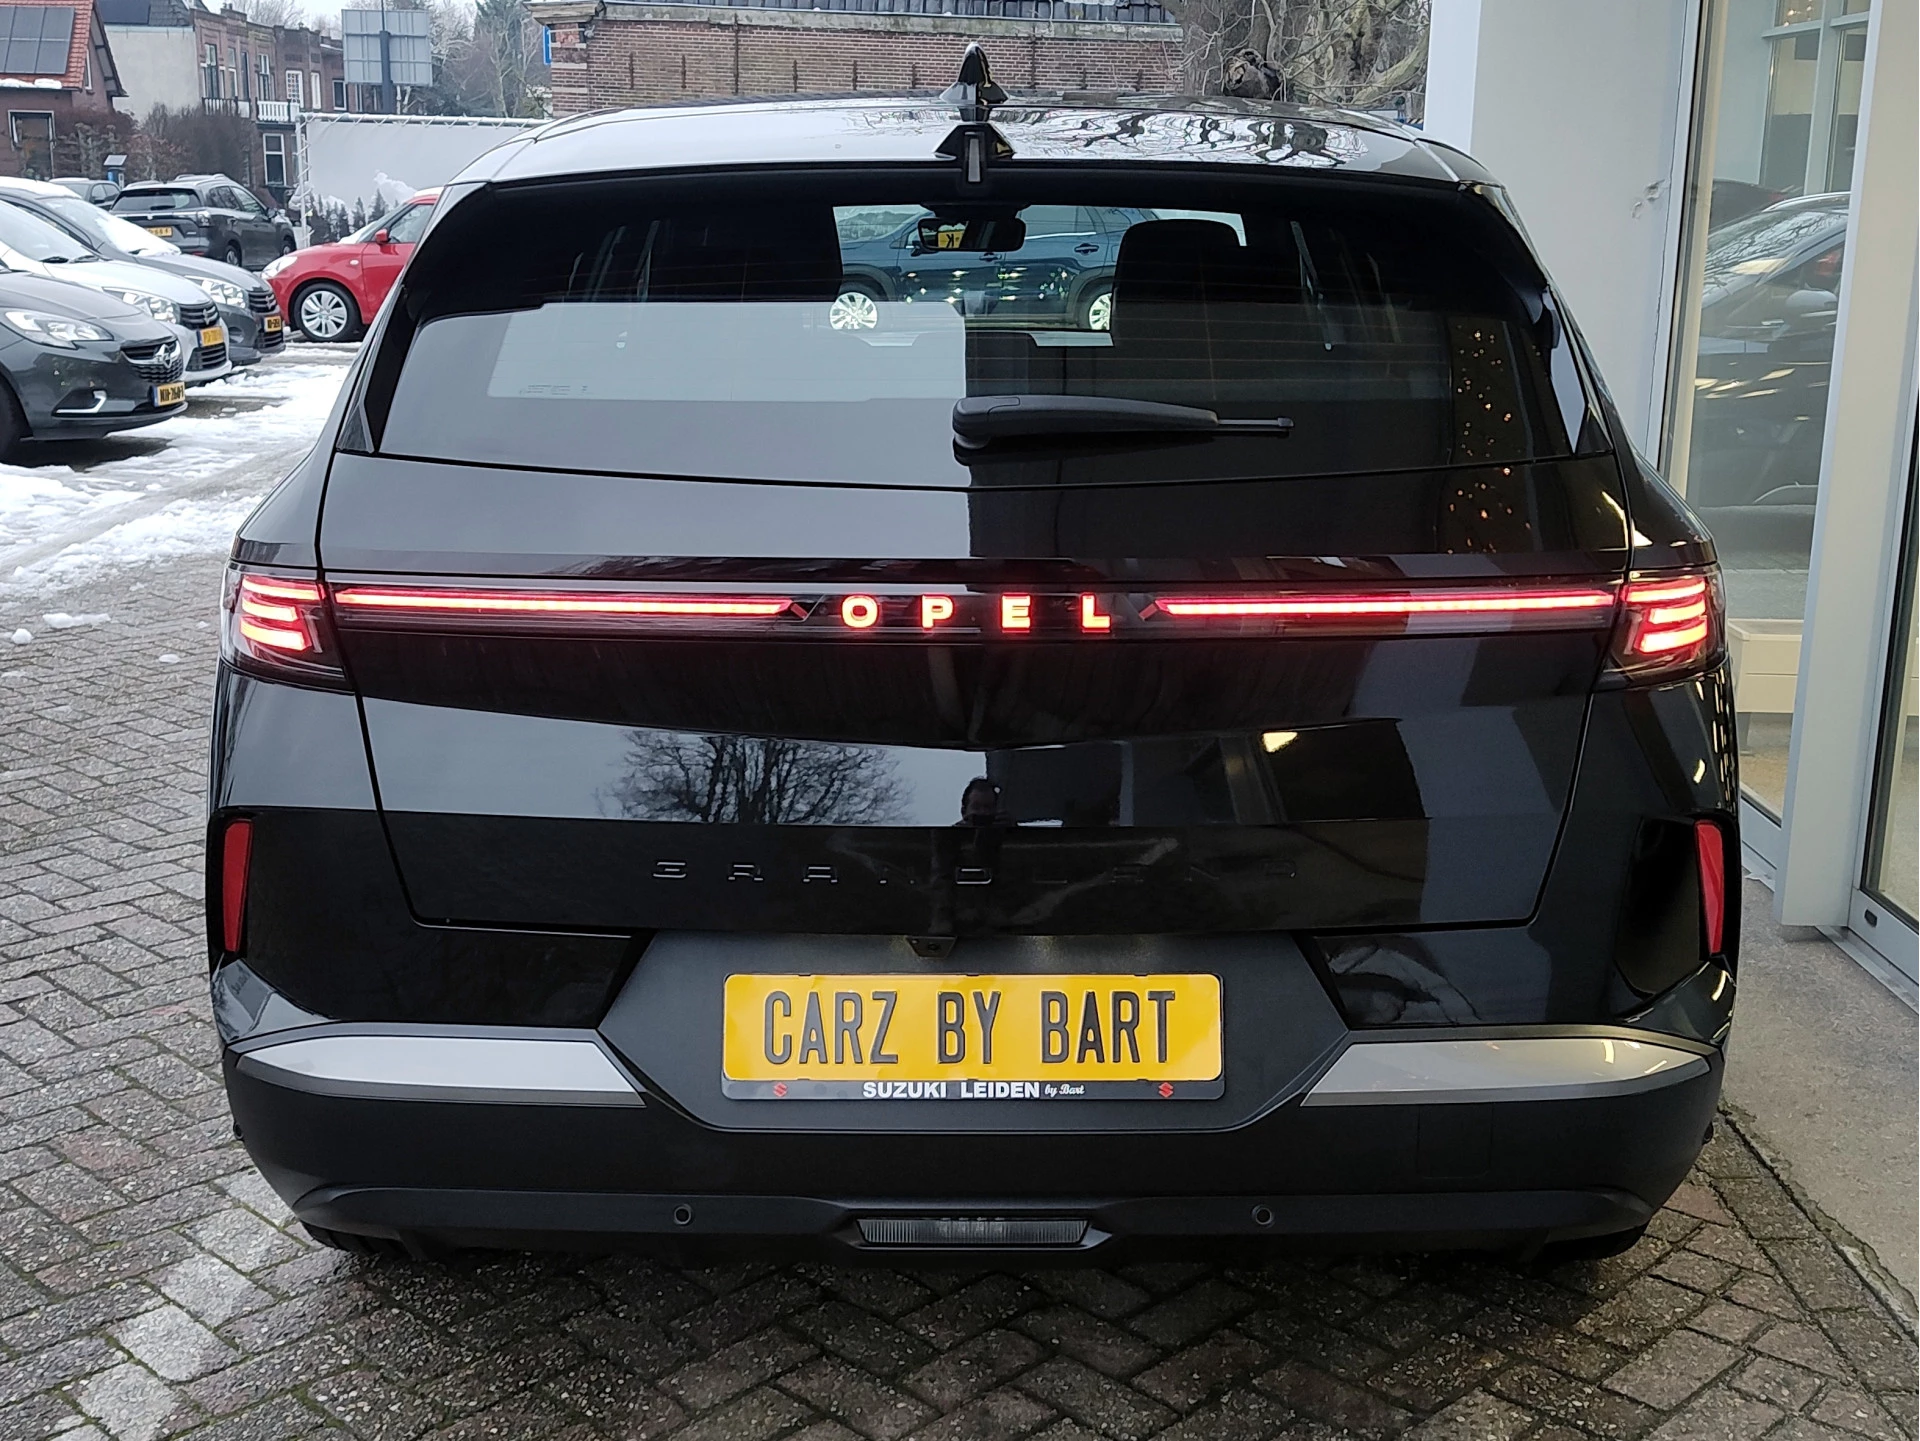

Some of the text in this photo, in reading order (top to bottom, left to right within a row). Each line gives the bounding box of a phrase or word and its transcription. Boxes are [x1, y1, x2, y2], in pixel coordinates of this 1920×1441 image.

[841, 593, 1111, 632] OPEL
[764, 991, 1175, 1064] CARZ BY BART
[863, 1081, 1085, 1098] SUZUKI LEIDEN by Bart
